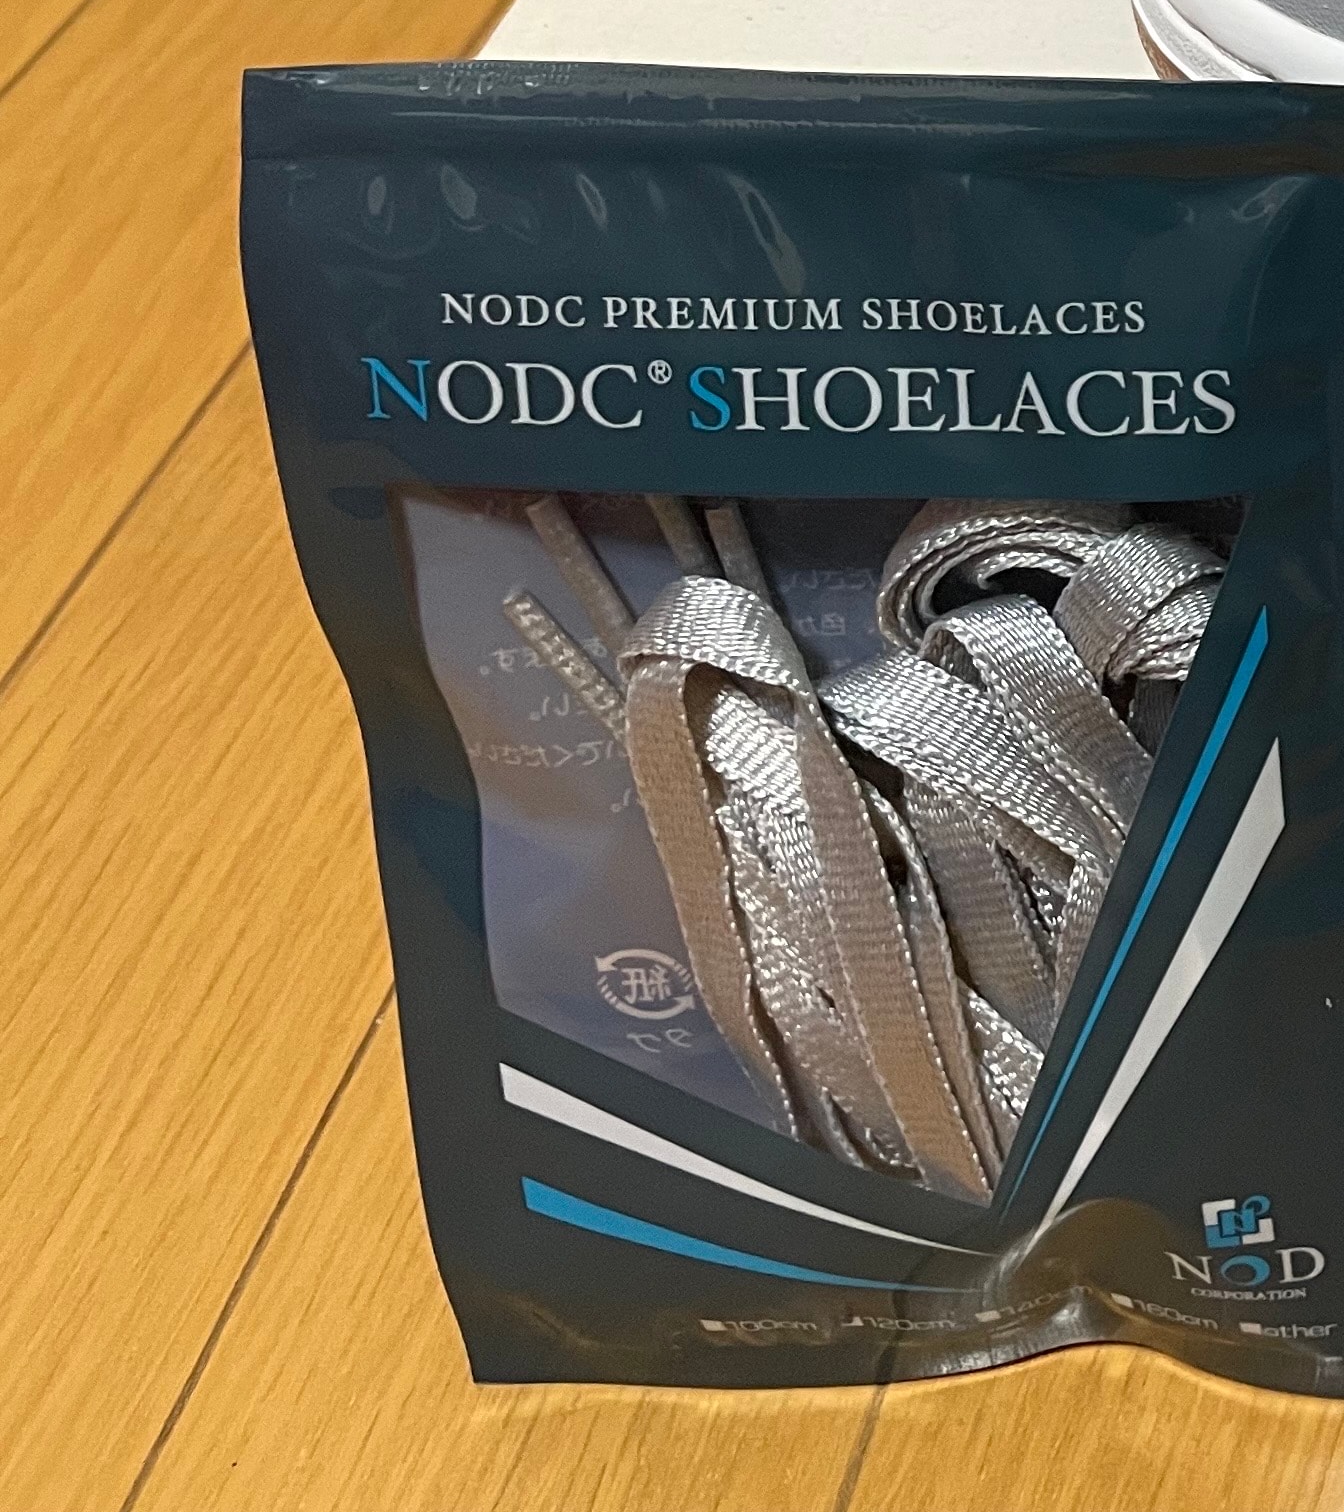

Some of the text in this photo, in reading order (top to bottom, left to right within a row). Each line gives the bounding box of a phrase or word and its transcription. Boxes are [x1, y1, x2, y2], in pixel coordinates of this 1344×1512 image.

[441, 293, 1146, 336] NODC PREMIUM SHOELACES
[688, 366, 1237, 437] SHOELACES
[1163, 1246, 1326, 1287] NOD
[1190, 1287, 1307, 1301] CORPORATION
[1263, 1321, 1337, 1339] other
